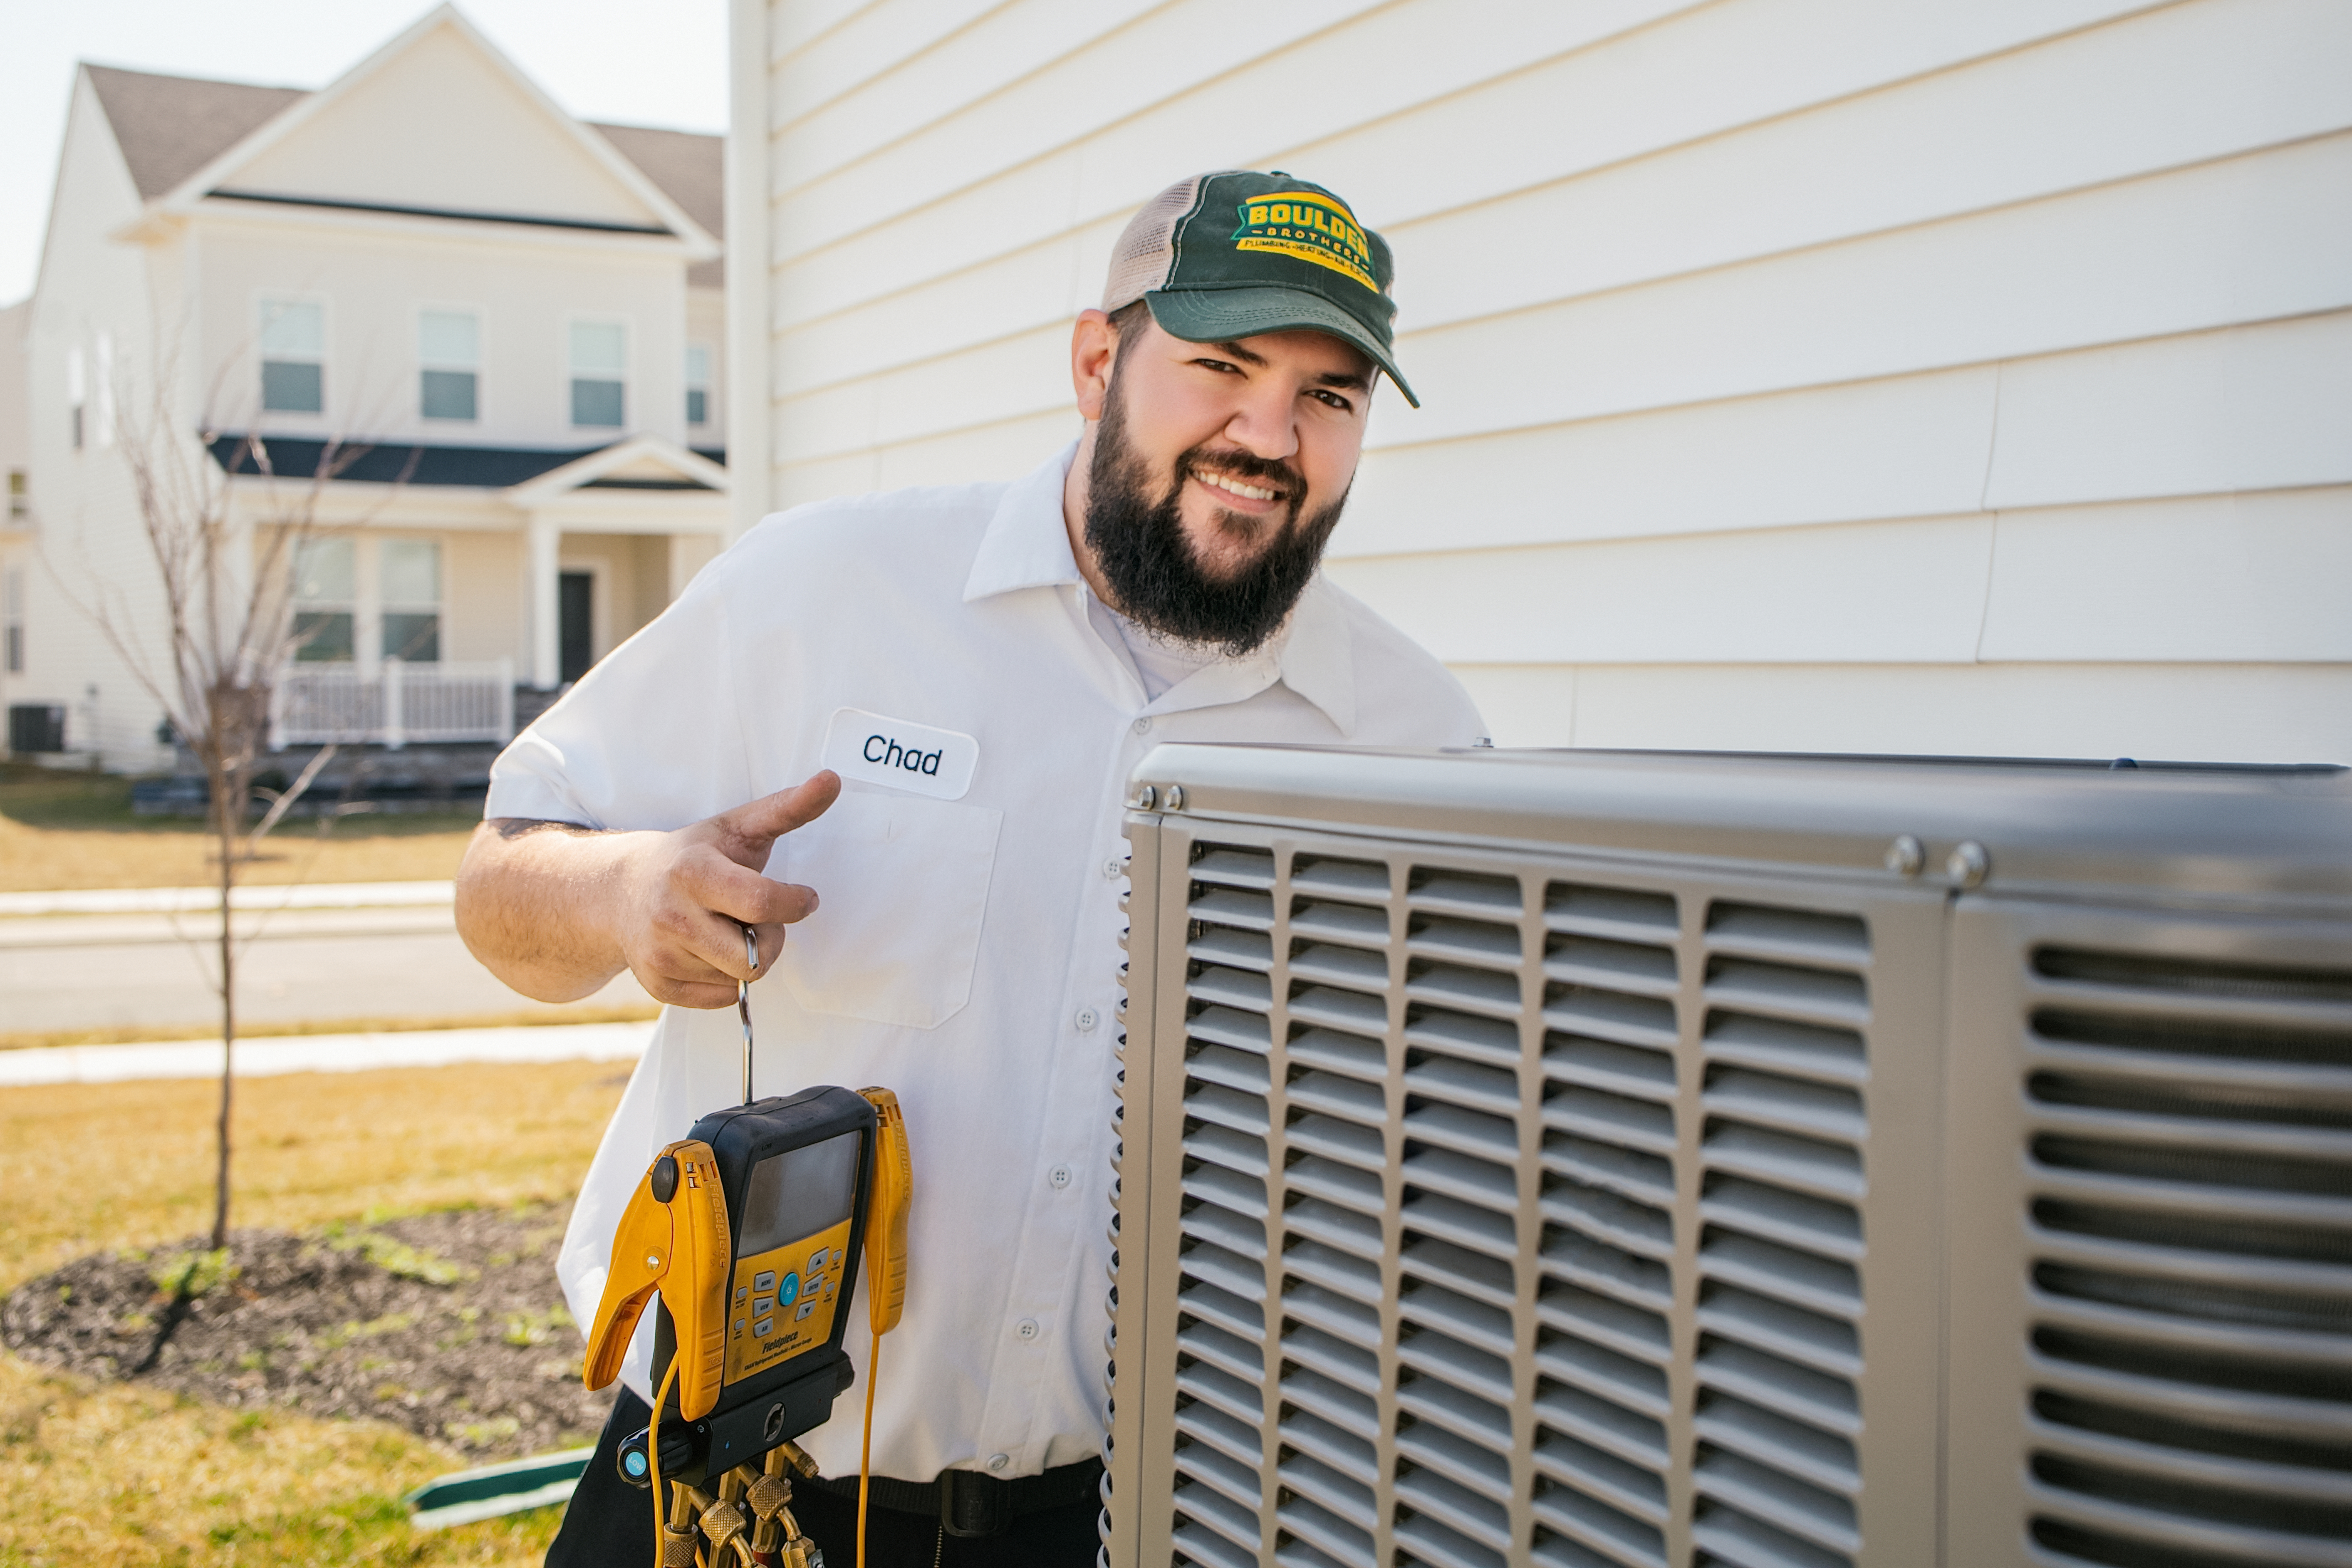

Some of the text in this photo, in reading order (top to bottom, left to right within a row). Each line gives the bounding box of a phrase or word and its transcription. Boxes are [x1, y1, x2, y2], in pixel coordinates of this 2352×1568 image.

[1249, 204, 1370, 263] BOULDEN
[1267, 227, 1360, 264] BROTHERS
[864, 735, 943, 776] Chad
[761, 1142, 773, 1152] LOW
[709, 1184, 727, 1268] Fieldpiece
[761, 1278, 772, 1287] MENU
[808, 1283, 819, 1291] ENTER
[760, 1302, 770, 1310] VIEW
[762, 1331, 799, 1354] Fieldpiece
[629, 1457, 644, 1471] LOW
